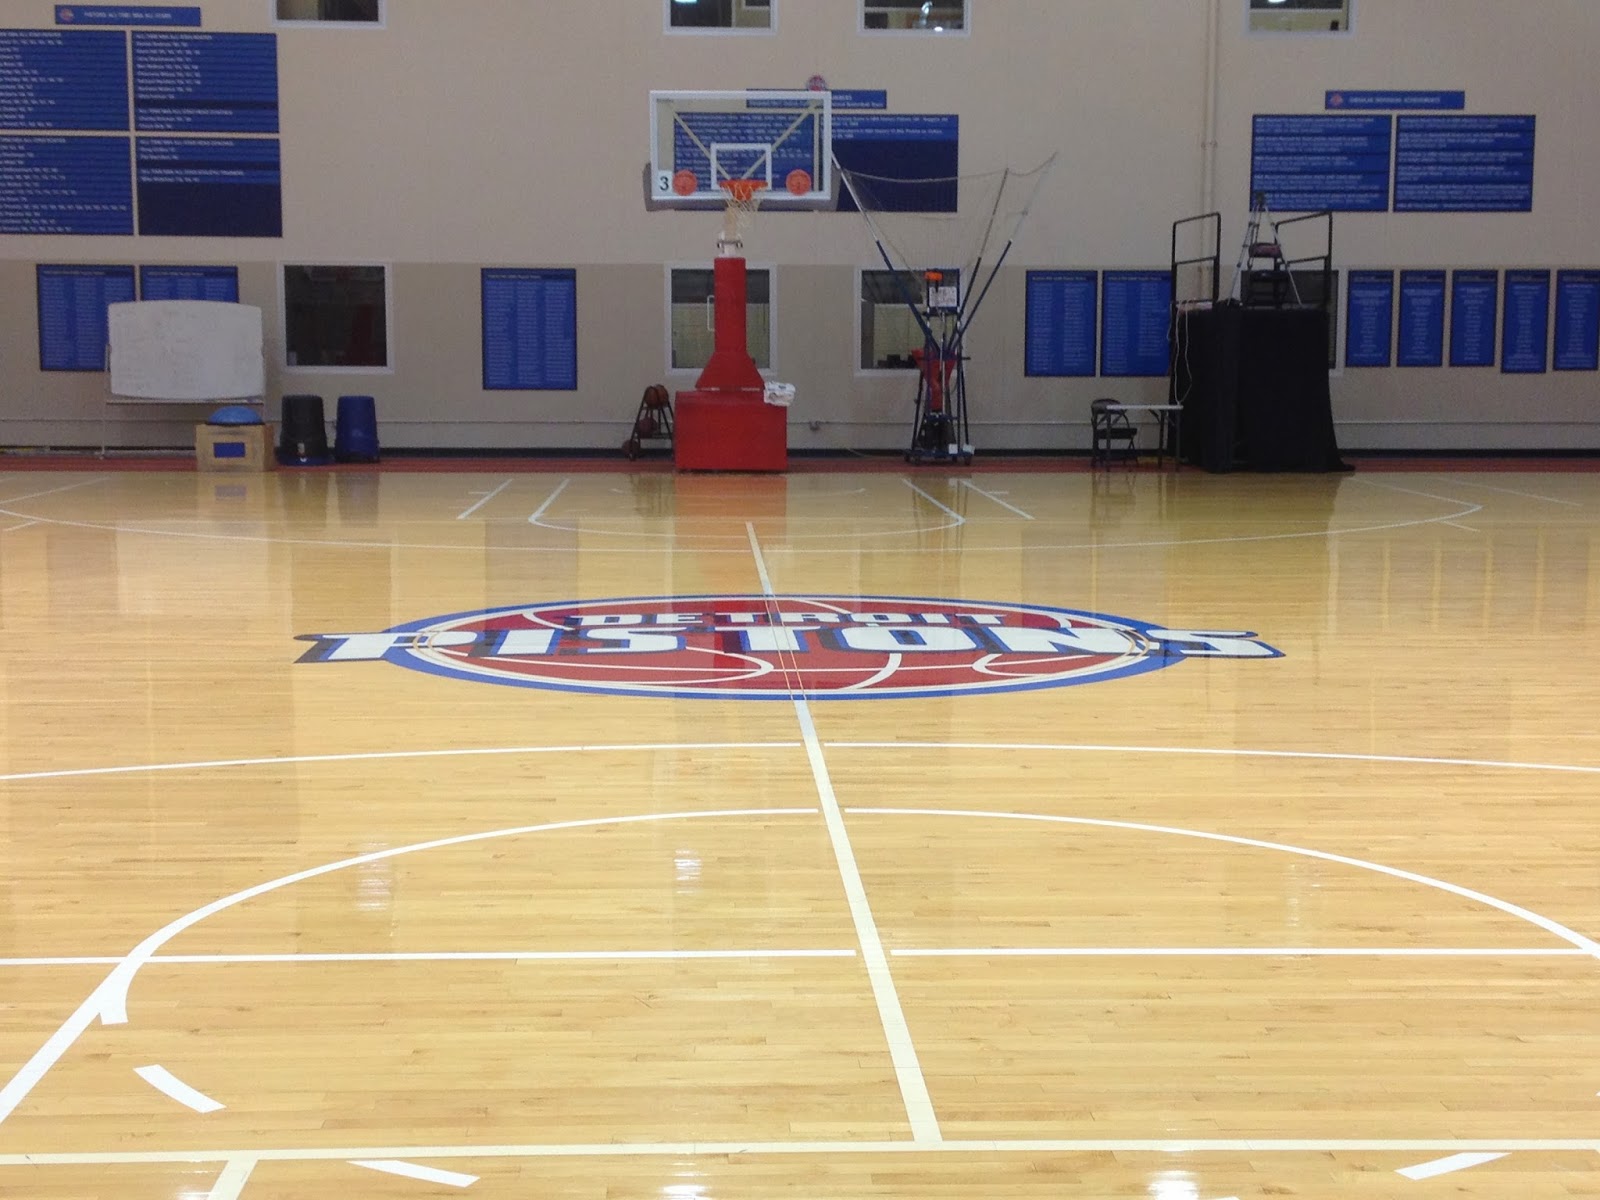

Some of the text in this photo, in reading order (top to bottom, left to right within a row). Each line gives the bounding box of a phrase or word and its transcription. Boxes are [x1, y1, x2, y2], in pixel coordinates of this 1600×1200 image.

[660, 175, 669, 191] 3
[567, 611, 1007, 626] DETROIT
[294, 623, 1286, 664] PISTONS
